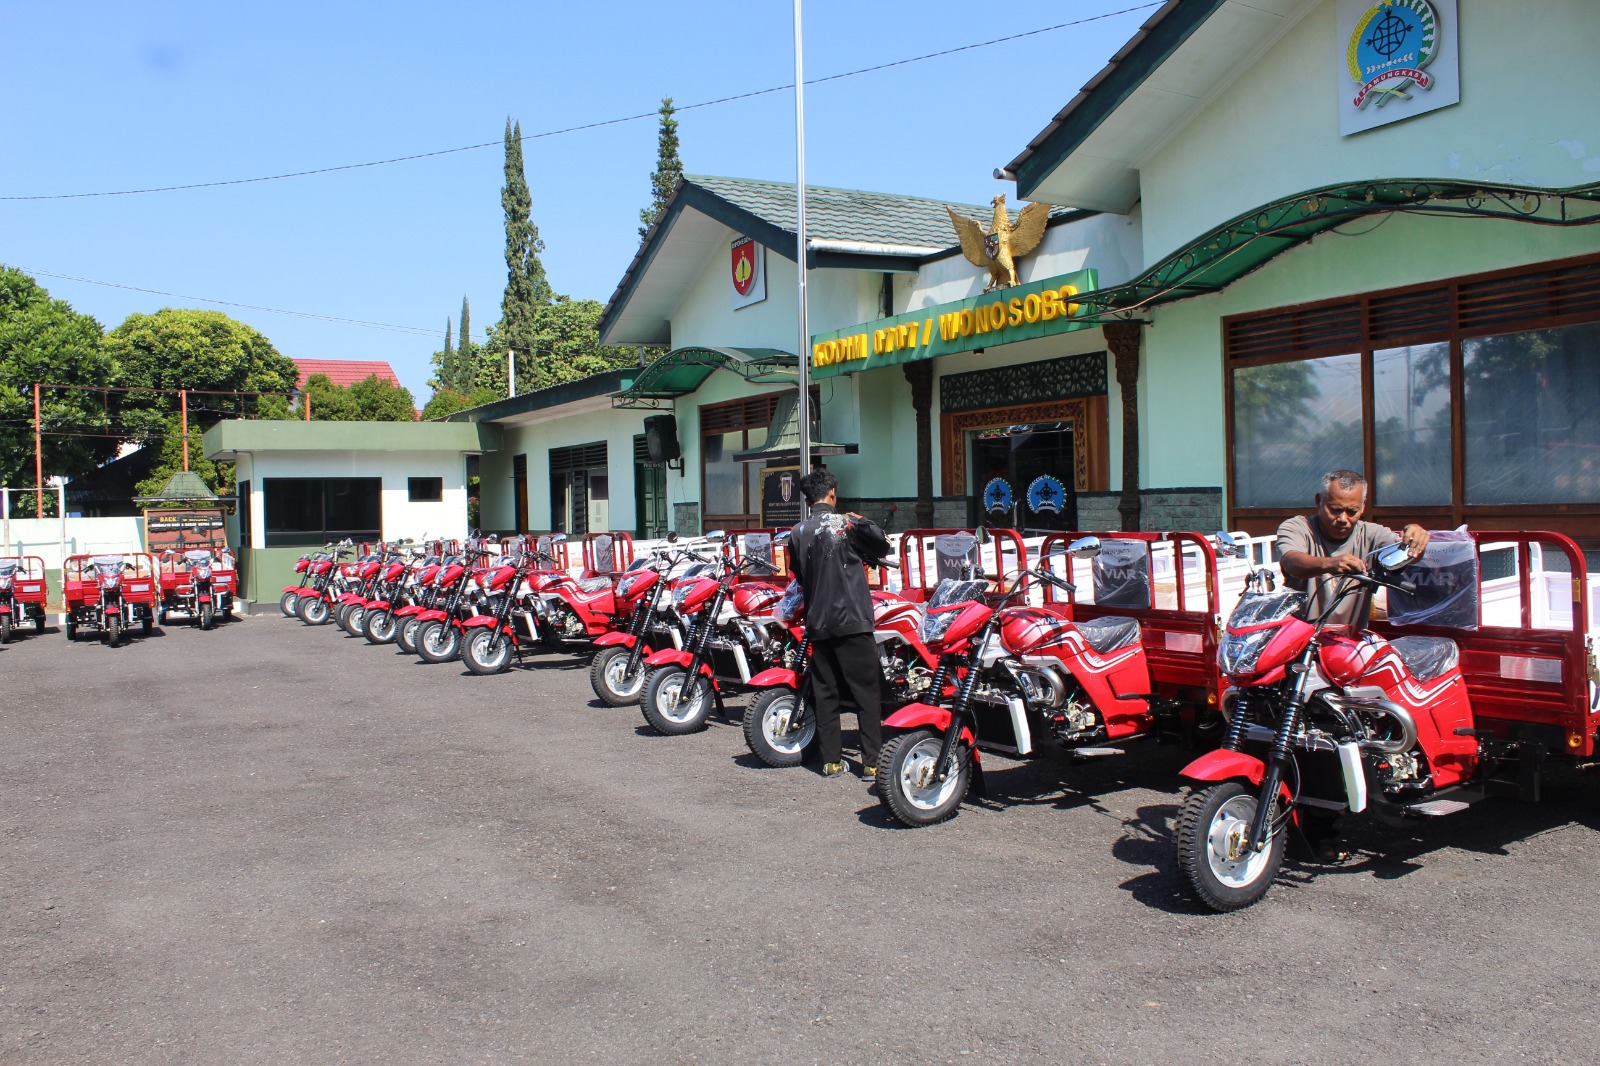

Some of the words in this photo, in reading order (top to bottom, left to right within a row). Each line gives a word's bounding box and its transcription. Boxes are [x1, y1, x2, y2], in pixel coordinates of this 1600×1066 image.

[1361, 70, 1420, 94] PAMUNGKAS
[813, 333, 868, 368] KODIM
[873, 321, 920, 355] 0707
[938, 284, 1080, 342] WONOSOBO
[1103, 568, 1137, 580] VIAR
[1400, 572, 1456, 587] VIAR
[879, 598, 899, 606] VIAR
[1036, 616, 1058, 626] VIAR
